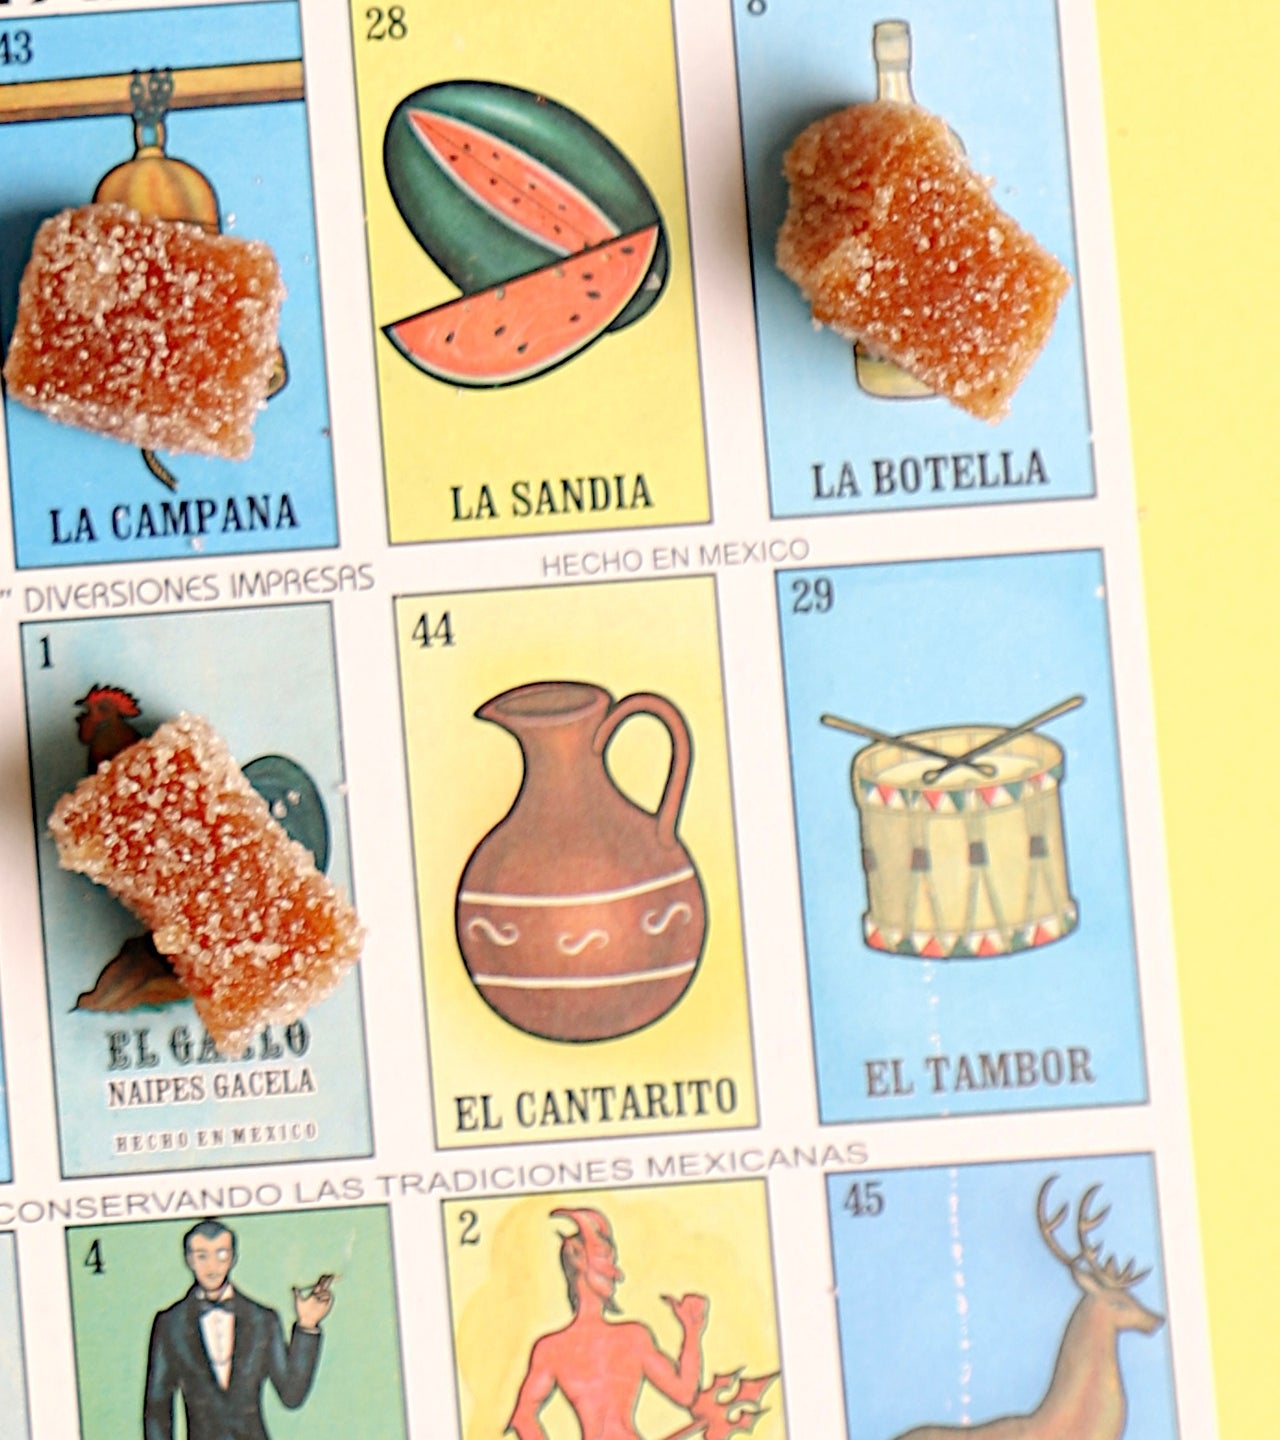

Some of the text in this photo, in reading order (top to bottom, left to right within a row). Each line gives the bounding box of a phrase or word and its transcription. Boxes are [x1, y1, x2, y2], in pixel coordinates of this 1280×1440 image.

[365, 8, 408, 41] 28
[810, 448, 1050, 500] LA BOTELLA
[451, 473, 654, 522] LA SANDIA
[49, 494, 300, 545] LA CAMPANA
[541, 536, 810, 578] HECHO EN MEXICO
[24, 563, 375, 613] DIVERSIONES IMPRESAS
[791, 578, 835, 614] 29
[411, 611, 456, 648] 44
[108, 1068, 316, 1107] NAIPES GACELA
[865, 1047, 1096, 1096] EL TAMBOR
[455, 1078, 738, 1131] EL CANTARITO
[296, 1176, 364, 1204] LAS
[376, 1156, 632, 1198] TRADICIONES
[646, 1142, 870, 1178] MEXICANAS
[843, 1182, 885, 1217] 45
[459, 1211, 480, 1245] 2
[84, 1240, 105, 1274] 4
